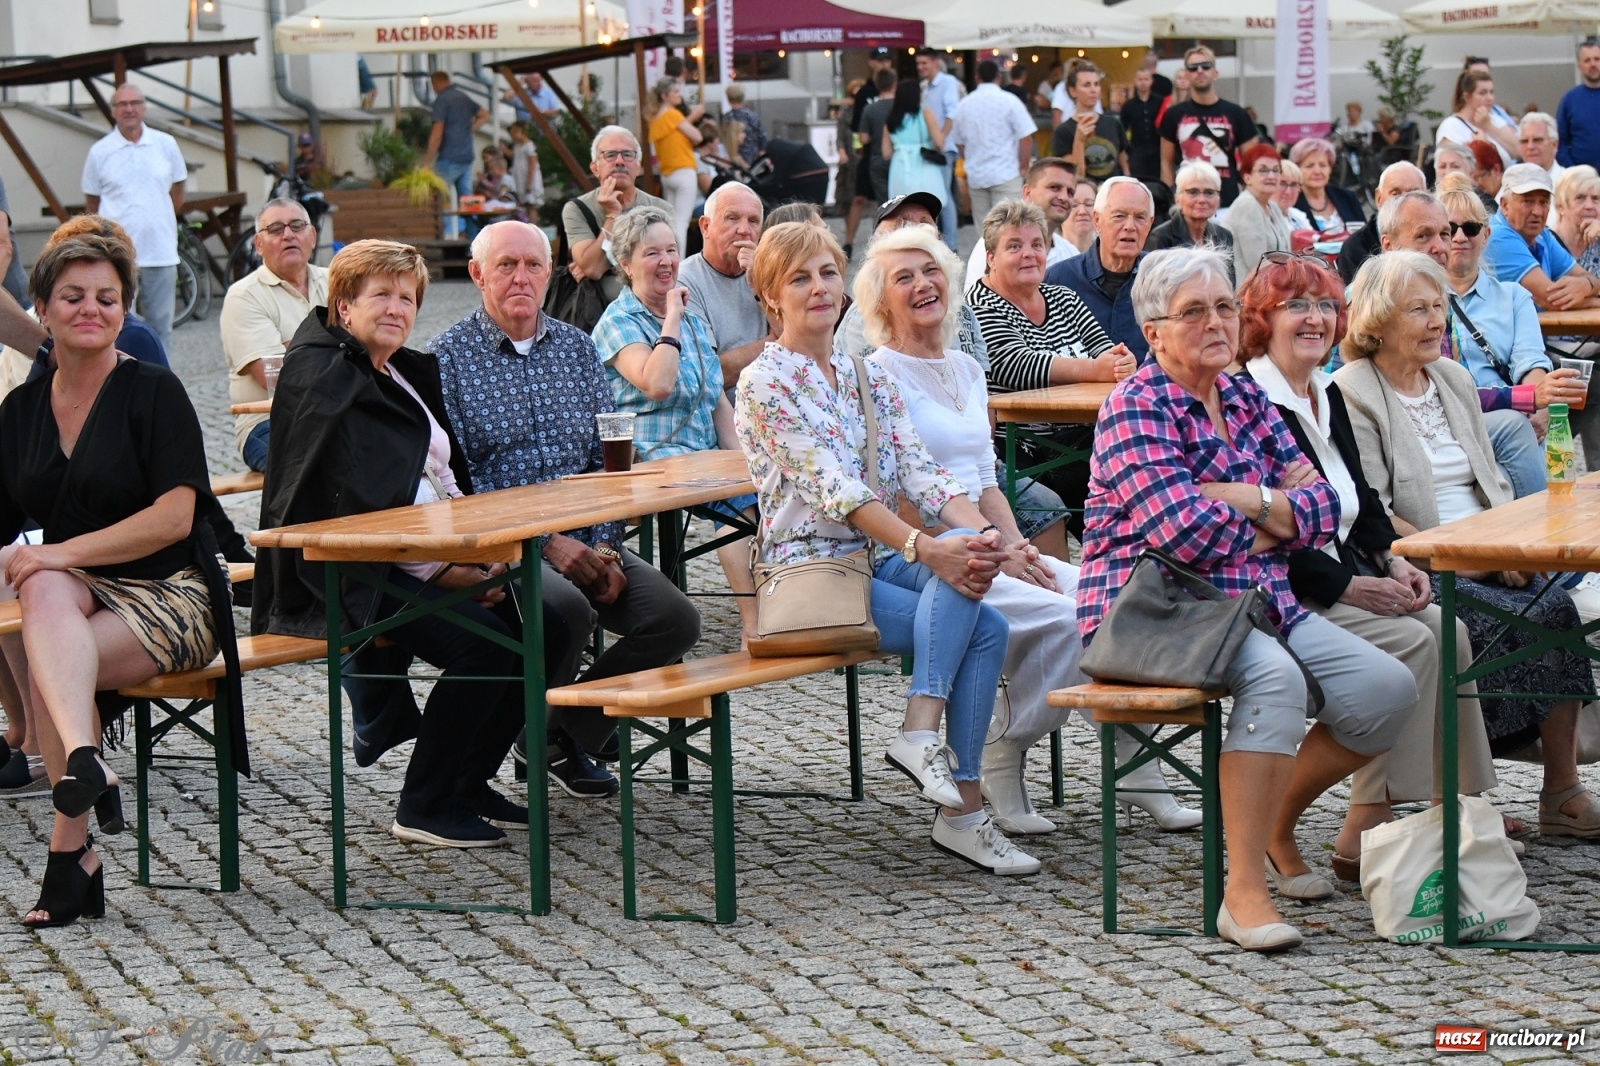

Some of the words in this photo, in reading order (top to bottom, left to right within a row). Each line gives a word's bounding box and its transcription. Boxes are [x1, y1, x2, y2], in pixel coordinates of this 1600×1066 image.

[376, 24, 498, 43] RACIBORSKIE
[1293, 0, 1316, 107] RACIBORS
[1396, 911, 1486, 944] PODEMIJ
